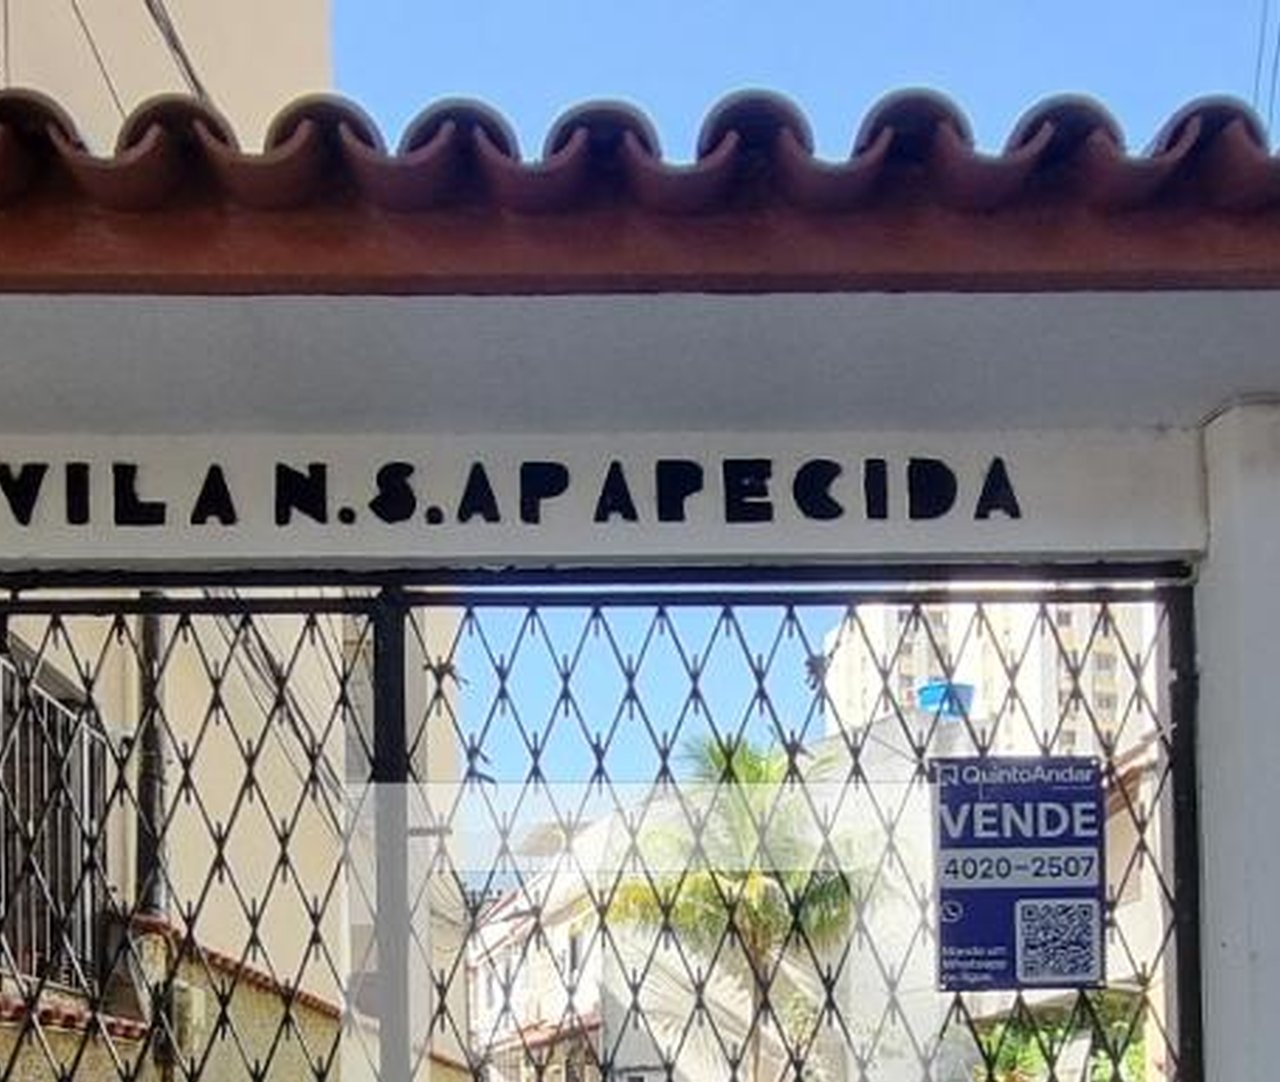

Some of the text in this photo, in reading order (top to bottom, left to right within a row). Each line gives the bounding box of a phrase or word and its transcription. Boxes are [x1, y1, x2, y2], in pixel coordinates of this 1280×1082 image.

[961, 764, 1095, 786] QuintoAndar
[939, 801, 1099, 839] VENDE
[943, 855, 1096, 881] 4020-2507
